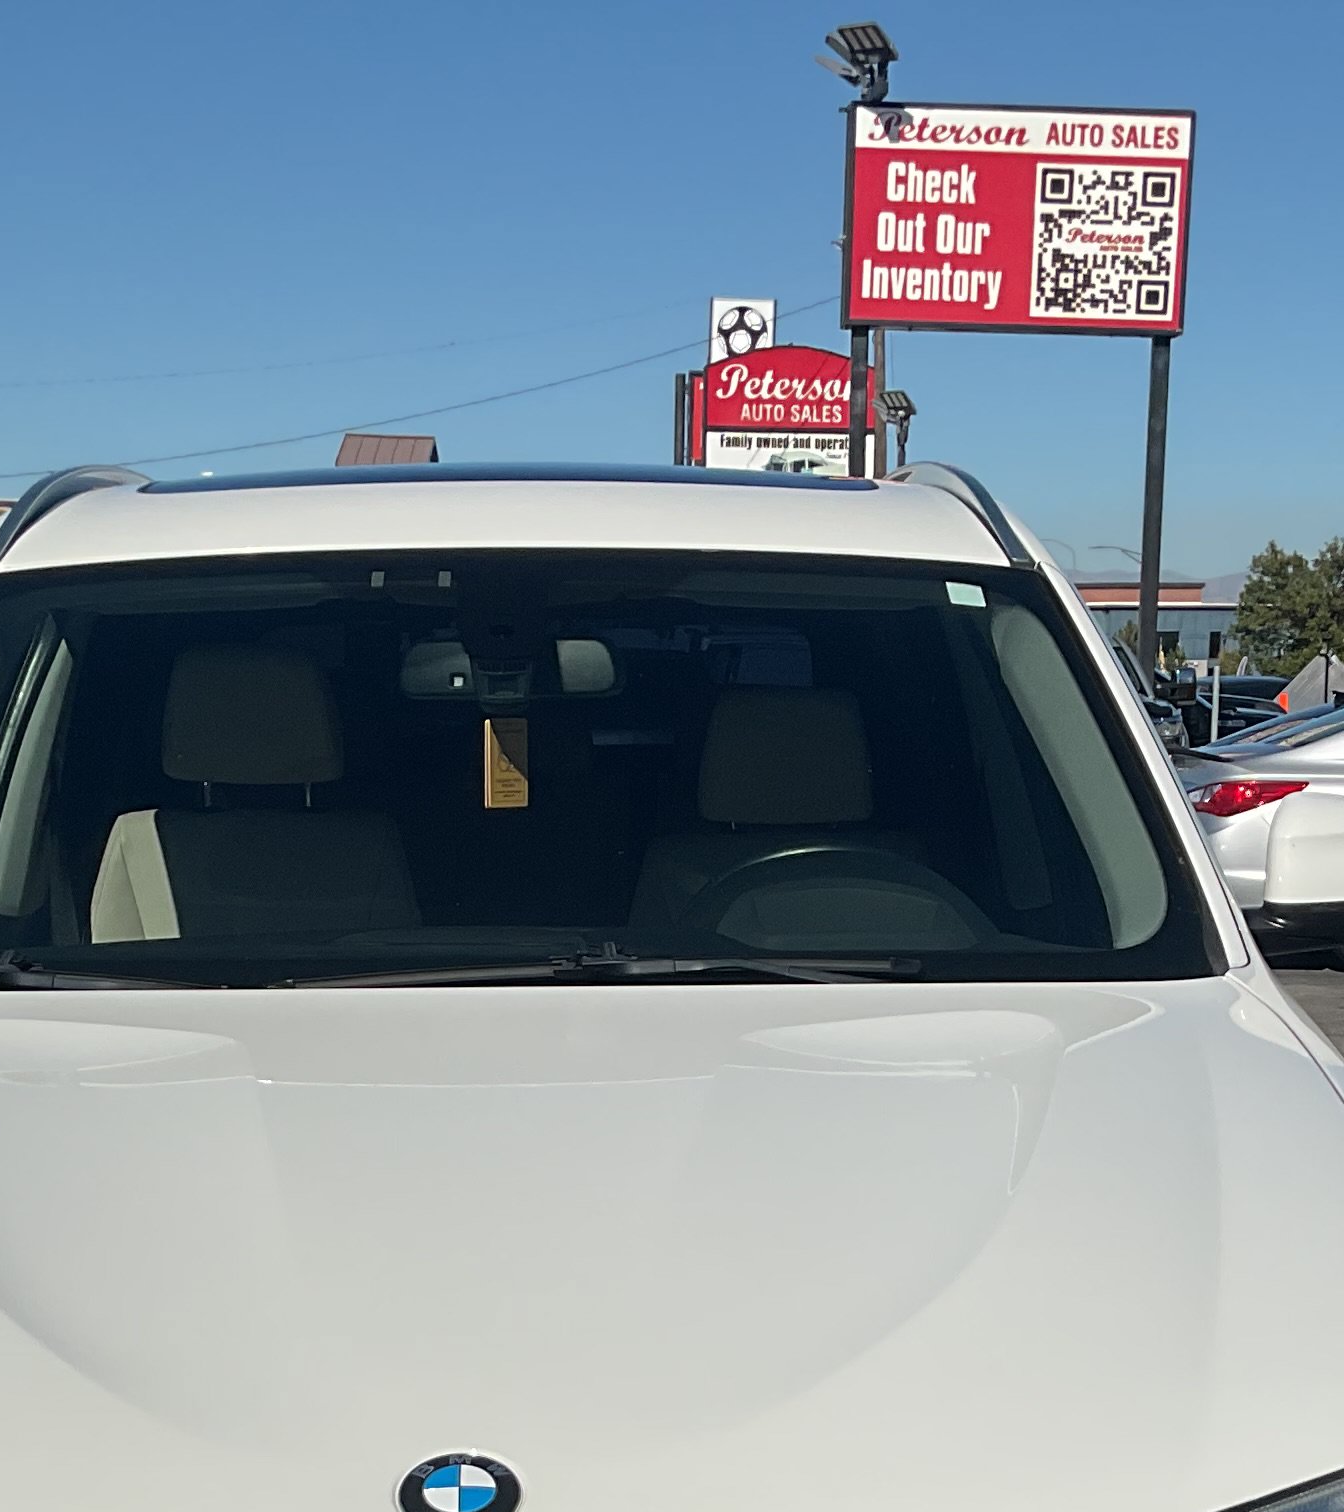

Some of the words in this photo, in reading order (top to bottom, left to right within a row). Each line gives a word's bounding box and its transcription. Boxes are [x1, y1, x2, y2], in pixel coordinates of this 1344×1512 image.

[868, 111, 1030, 147] Peterson
[1046, 122, 1104, 148] AUTO
[1111, 124, 1180, 150] SALES
[886, 161, 977, 205] Check
[876, 211, 927, 253] Out
[935, 213, 991, 256] Our
[1065, 227, 1145, 243] Peterson
[861, 259, 1003, 311] Inventory
[740, 404, 786, 422] AUTO
[790, 405, 843, 424] SALES
[720, 434, 753, 450] Family
[756, 436, 790, 449] owned
[793, 436, 811, 449] and
[412, 1455, 511, 1479] BMW
